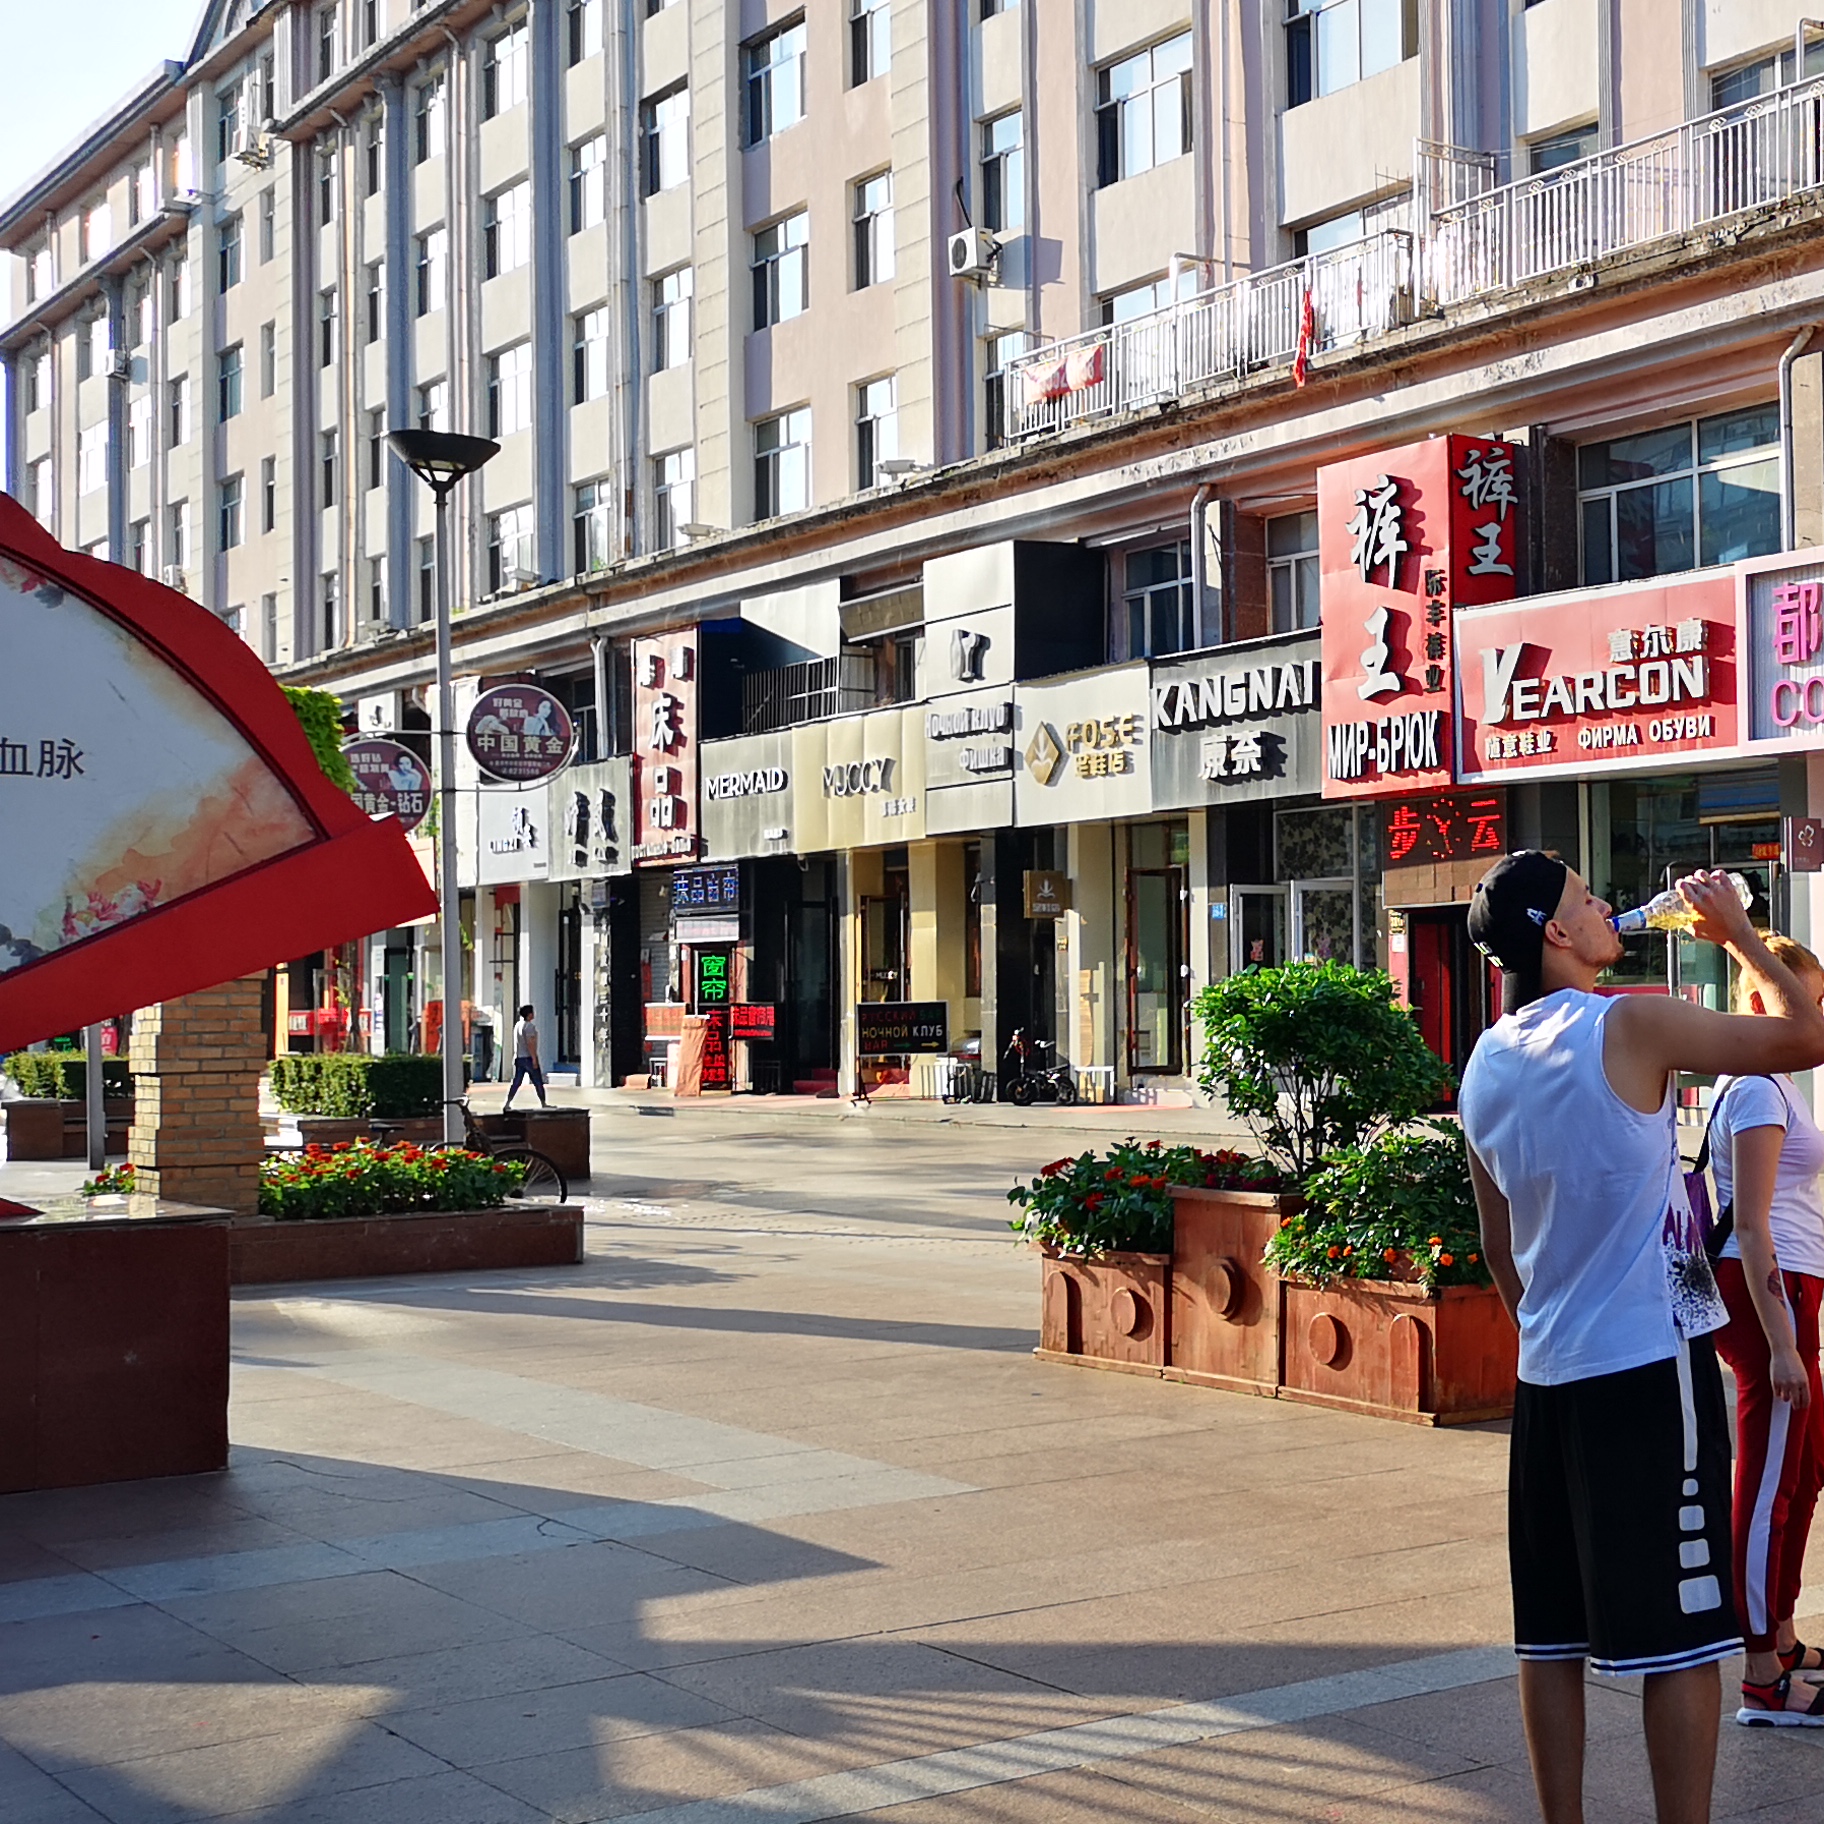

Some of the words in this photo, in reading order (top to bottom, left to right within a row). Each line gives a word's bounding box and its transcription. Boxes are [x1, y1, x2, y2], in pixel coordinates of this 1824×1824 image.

[1456, 447, 1518, 577] 裤王
[1345, 474, 1408, 701] 裤王
[1607, 617, 1704, 663] 意尔康
[1150, 660, 1314, 729] KANGNAI
[1479, 642, 1705, 725] YEARCON
[477, 734, 564, 755] 中国黄金
[1066, 713, 1133, 752] FOSE
[1327, 709, 1438, 779] МИР-БРЮК
[1578, 723, 1638, 750] ФИРМА
[1648, 715, 1711, 742] ОБУВИ
[0, 737, 85, 779] 血脉
[705, 767, 784, 799] MERMAID
[701, 955, 727, 1001] 窗帘
[861, 1024, 908, 1038] НОЧНОЙ
[913, 1025, 944, 1037] КЛУБ
